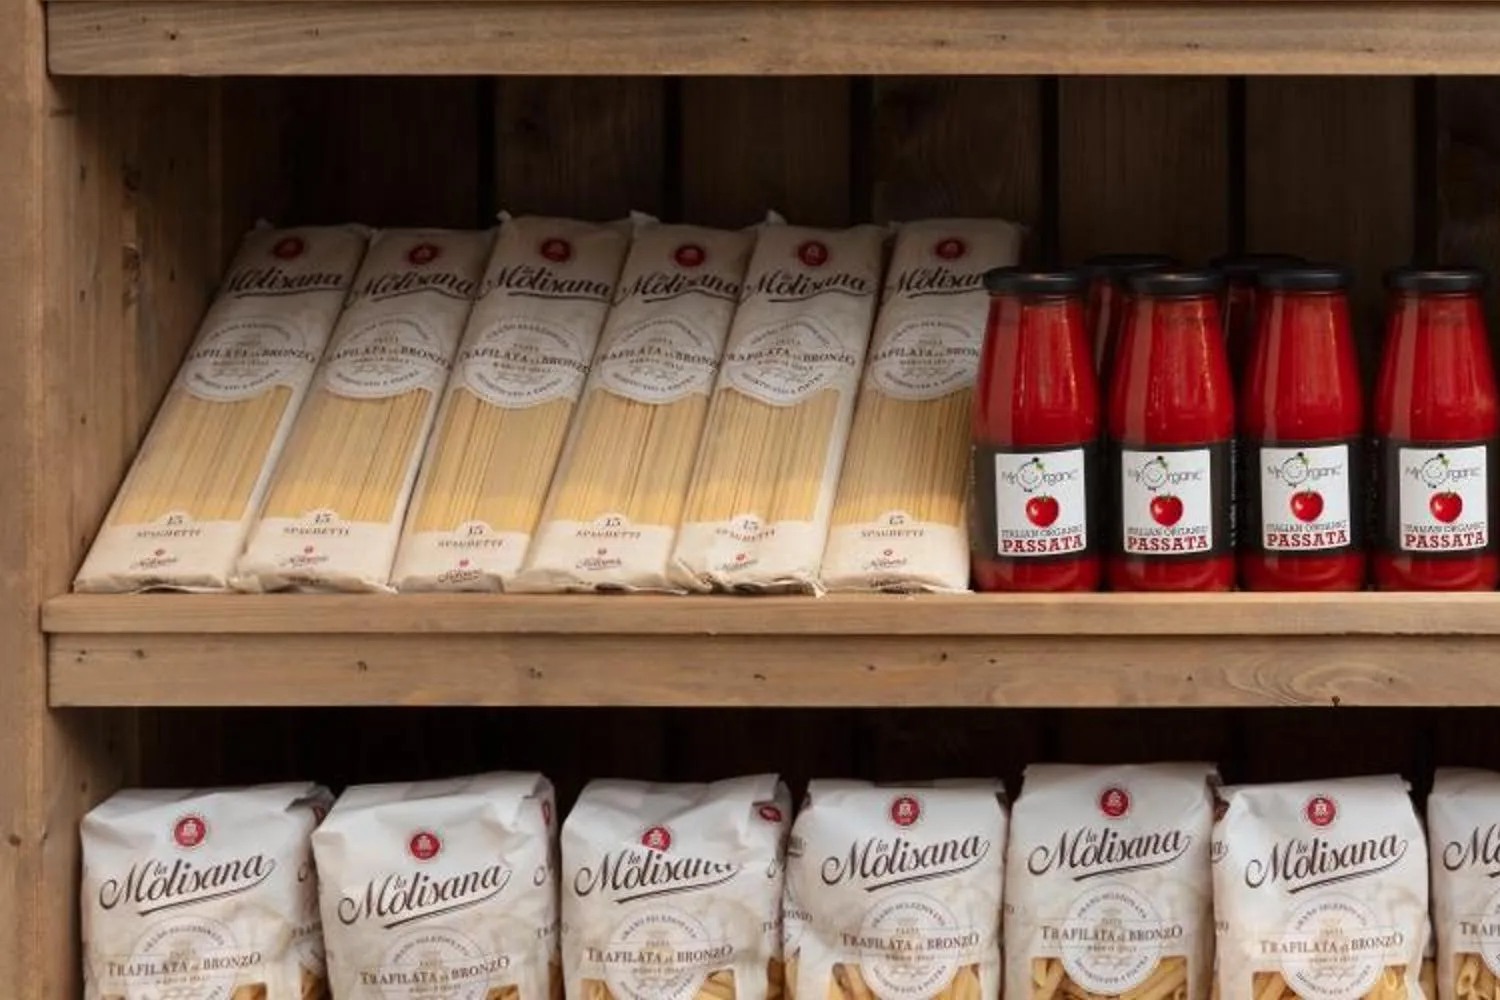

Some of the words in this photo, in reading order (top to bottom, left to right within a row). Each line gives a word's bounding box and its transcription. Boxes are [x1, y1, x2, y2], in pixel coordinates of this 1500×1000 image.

[1002, 535, 1084, 552] PASSATA
[1128, 535, 1208, 550] PASSATA
[1266, 531, 1347, 547] PASSATA
[1405, 532, 1485, 548] PASSATA
[821, 834, 990, 885] Molisana
[1027, 827, 1196, 876] Molisana
[1245, 832, 1408, 889] Molisana
[99, 854, 276, 910] Molisana
[338, 866, 513, 926] Molisana
[840, 932, 913, 951] TRAFILATA
[926, 933, 979, 950] BRONZO
[1041, 925, 1116, 942] TRAFILATA
[1129, 925, 1183, 942] BRONZO
[1260, 939, 1338, 955] TRAFILATA
[1351, 931, 1403, 950] BRONZO
[106, 959, 188, 978] TRAFILATA
[202, 952, 262, 971] BRONZO
[587, 946, 664, 964] TRAFILATA
[677, 945, 734, 963] BRONZO
